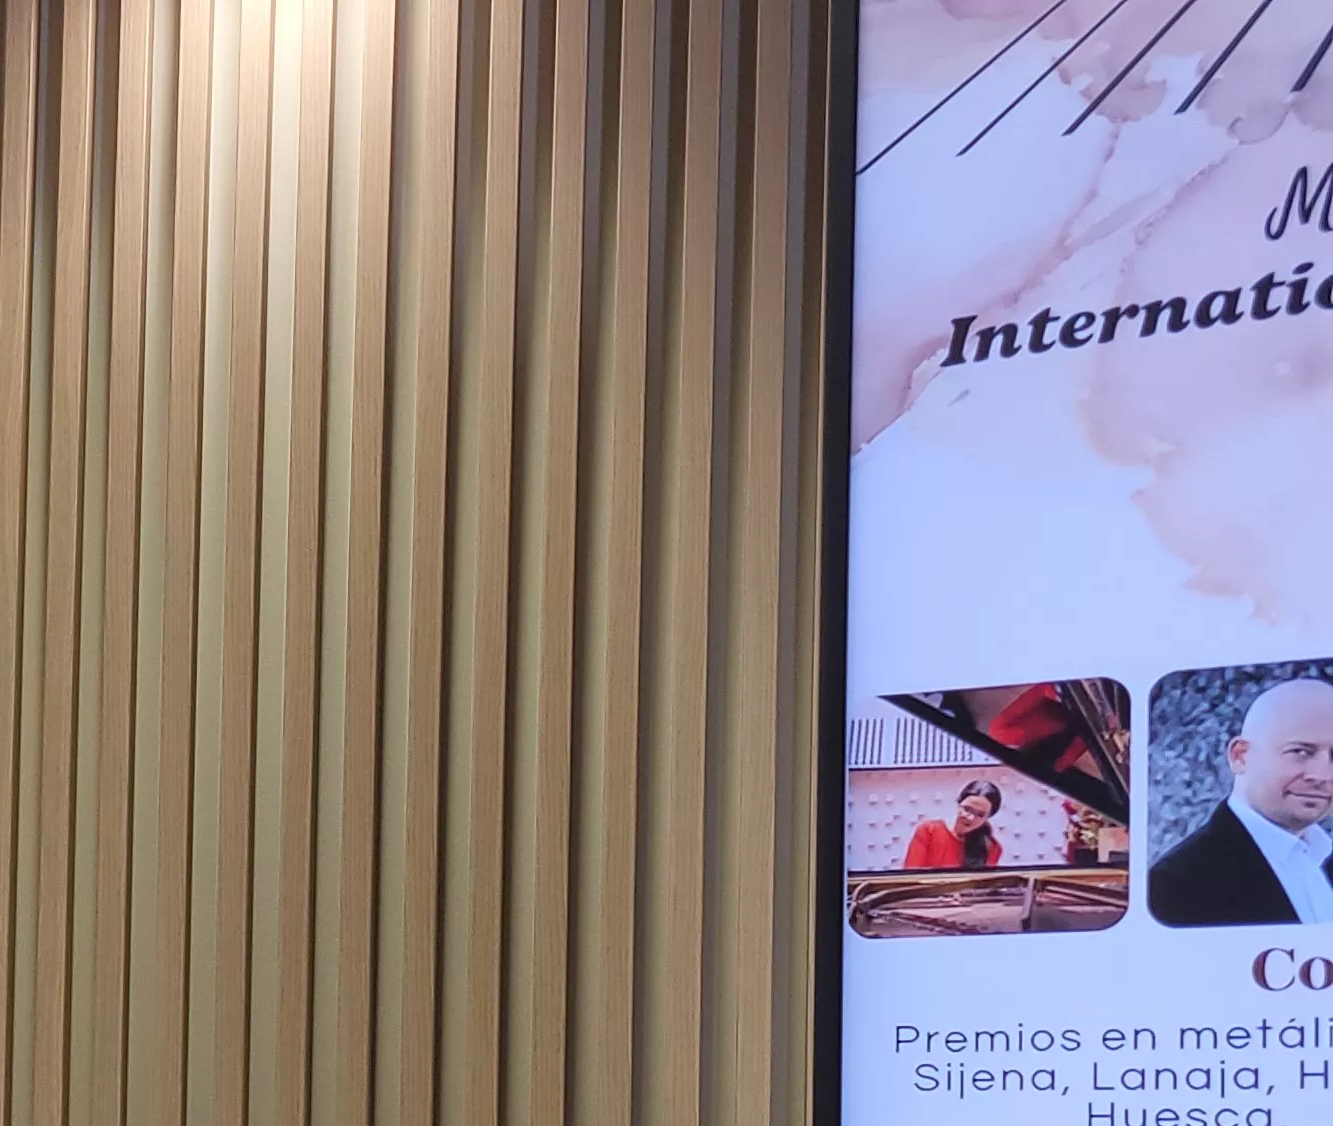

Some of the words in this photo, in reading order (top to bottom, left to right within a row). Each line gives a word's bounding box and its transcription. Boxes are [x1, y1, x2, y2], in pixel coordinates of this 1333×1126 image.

[895, 1023, 1082, 1053] Premios
[1102, 1027, 1157, 1051] en
[913, 1063, 1071, 1099] Sijena,
[1093, 1060, 1275, 1098] Lanaja,
